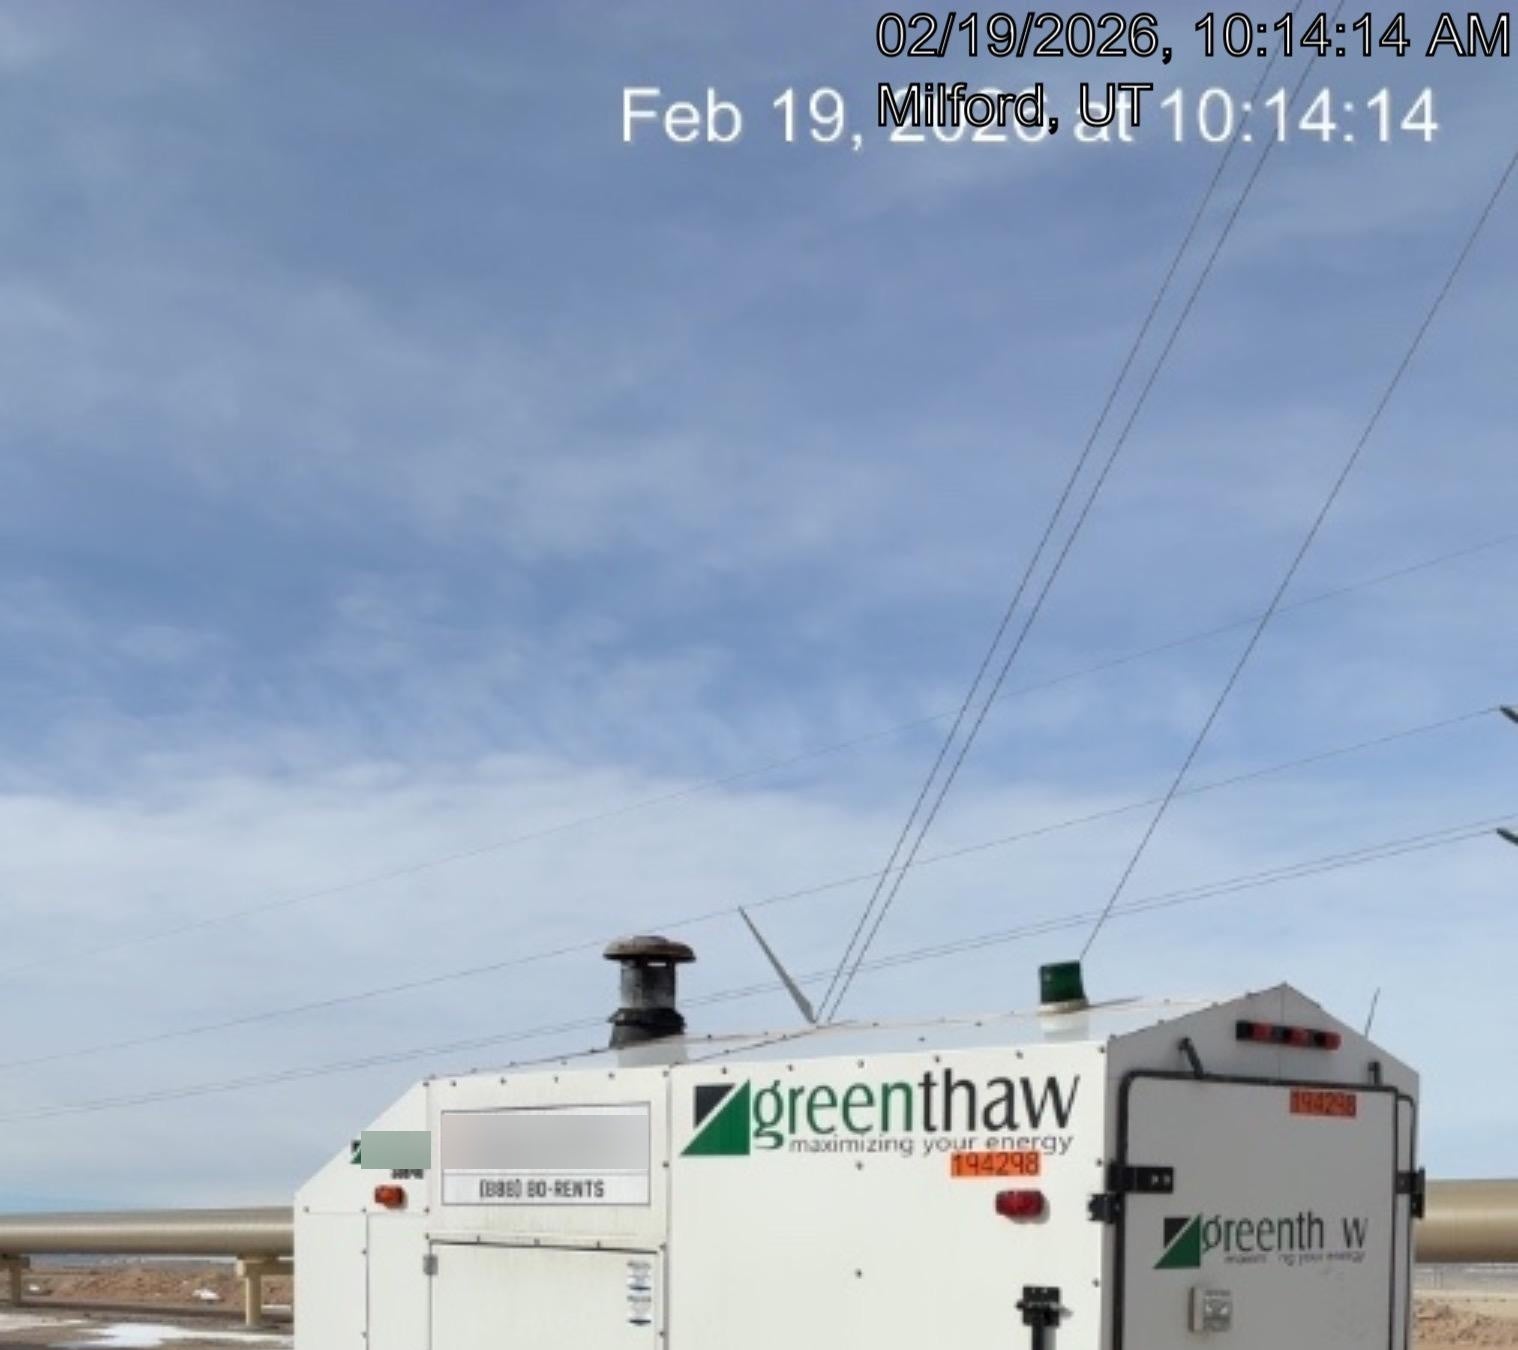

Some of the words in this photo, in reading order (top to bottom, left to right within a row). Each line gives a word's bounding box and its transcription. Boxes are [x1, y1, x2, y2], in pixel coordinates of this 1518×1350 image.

[752, 1068, 1080, 1150] greenthaw
[789, 1134, 913, 1155] maximizing
[922, 1136, 975, 1154] your
[985, 1133, 1074, 1155] energy
[953, 1153, 1039, 1176] 194298
